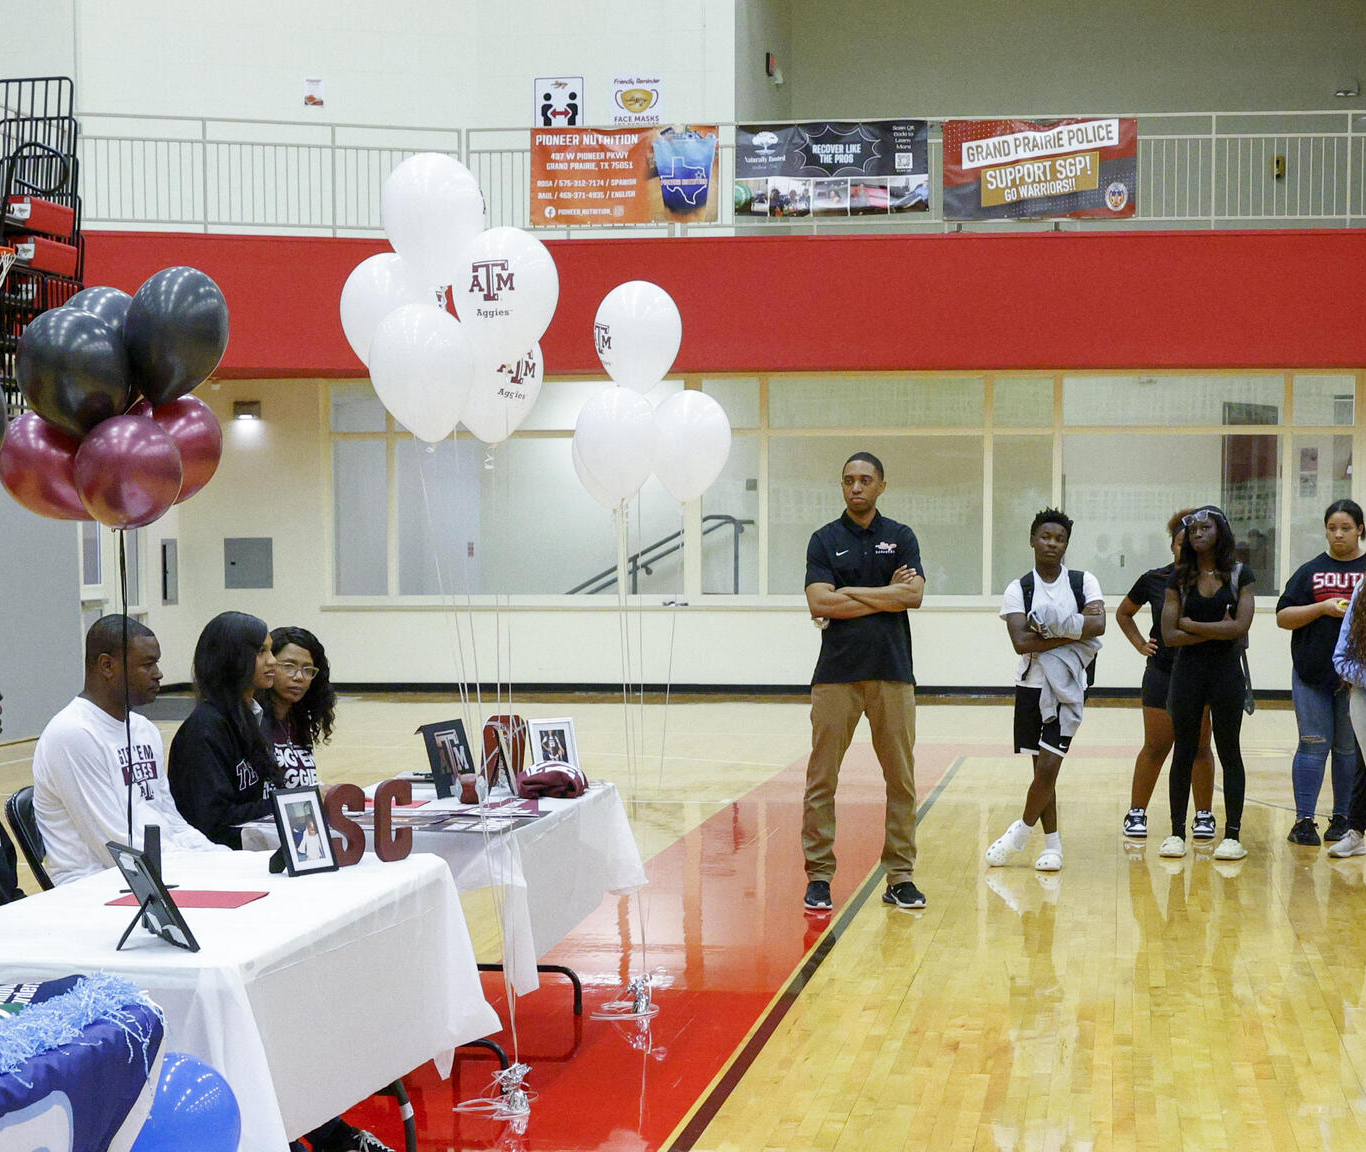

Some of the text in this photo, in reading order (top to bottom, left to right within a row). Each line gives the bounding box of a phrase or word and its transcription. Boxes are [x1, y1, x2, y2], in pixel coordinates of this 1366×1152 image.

[634, 115, 660, 123] MASKS
[535, 133, 639, 146] PIONEER NUTRITION
[967, 124, 1114, 163] GRAND PRAIRIE POLICE
[812, 143, 862, 155] RECOVER LIKE
[565, 152, 575, 160] W
[576, 152, 605, 160] PIONEER
[606, 151, 629, 160] PKWY
[819, 154, 854, 164] THE PROS
[600, 162, 610, 170] TX
[986, 155, 1092, 190] SUPPORT SGP!
[1004, 178, 1076, 201] GO WARRIORS!!
[476, 308, 510, 318] Aggies
[1312, 572, 1366, 589] SOUT
